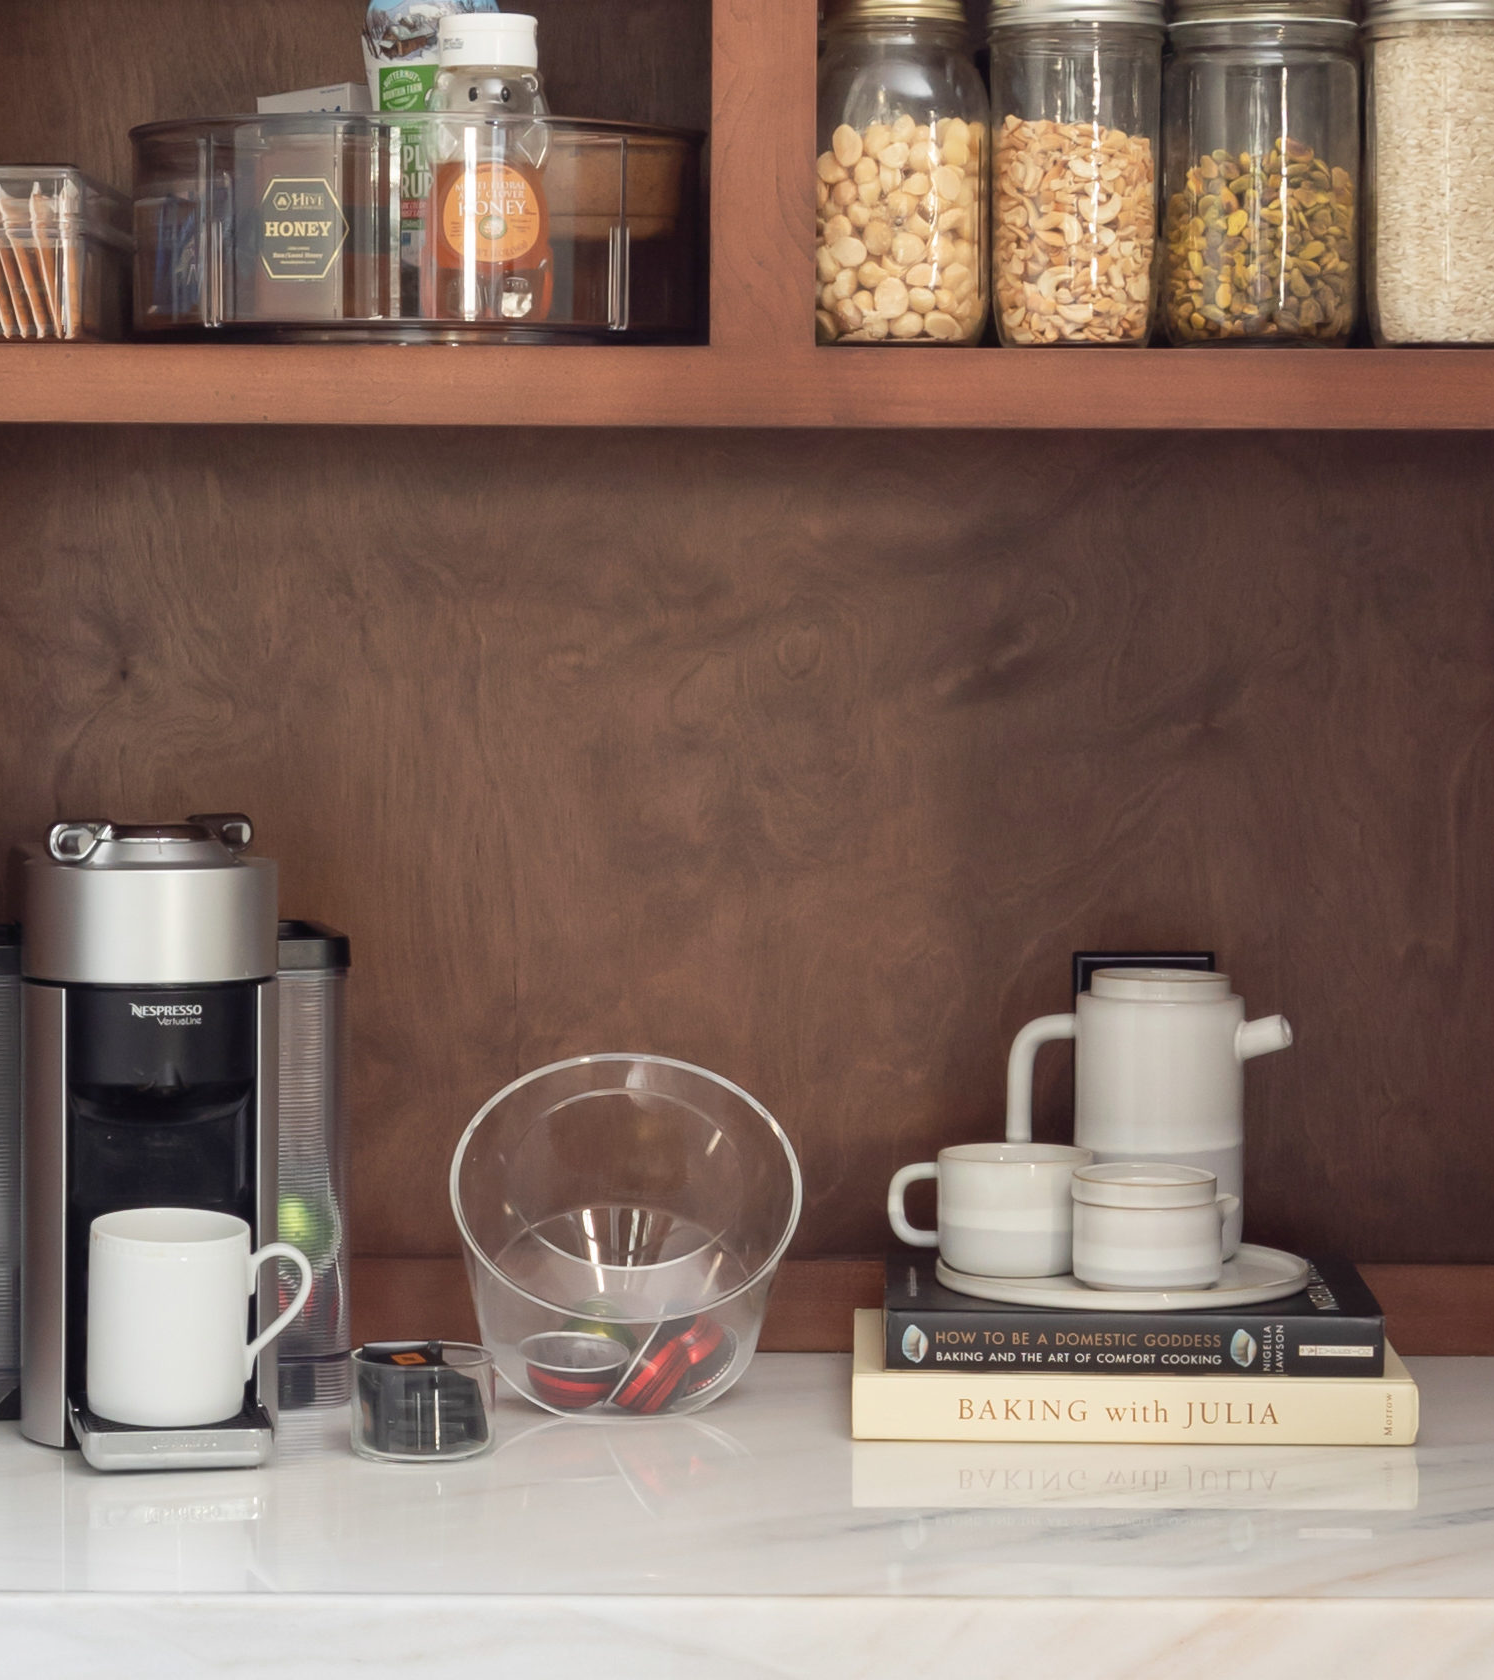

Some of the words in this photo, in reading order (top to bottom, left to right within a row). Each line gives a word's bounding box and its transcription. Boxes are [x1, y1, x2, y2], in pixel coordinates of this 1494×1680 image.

[458, 200, 526, 217] HONEY
[265, 221, 332, 237] HONEY
[128, 1003, 202, 1018] NESPRESSO
[935, 1331, 977, 1345] HOW
[983, 1331, 1005, 1345] TO
[1012, 1332, 1030, 1346] BE
[1037, 1332, 1048, 1346] A
[1055, 1332, 1138, 1347] DOMESTIC
[1144, 1333, 1222, 1348] GODDESS
[1263, 1325, 1272, 1372] NIGELLA
[1275, 1324, 1285, 1373] LAWSON
[936, 1351, 984, 1362] BAKING
[988, 1351, 1016, 1362] AND
[1021, 1352, 1042, 1363] THE
[1048, 1352, 1069, 1363] ART
[1074, 1352, 1091, 1363] OF
[1096, 1353, 1156, 1364] COMFORT
[1160, 1354, 1222, 1365] COOKING
[958, 1398, 1088, 1422] BAKING
[1105, 1400, 1169, 1423] with
[1182, 1402, 1279, 1429] JULIA
